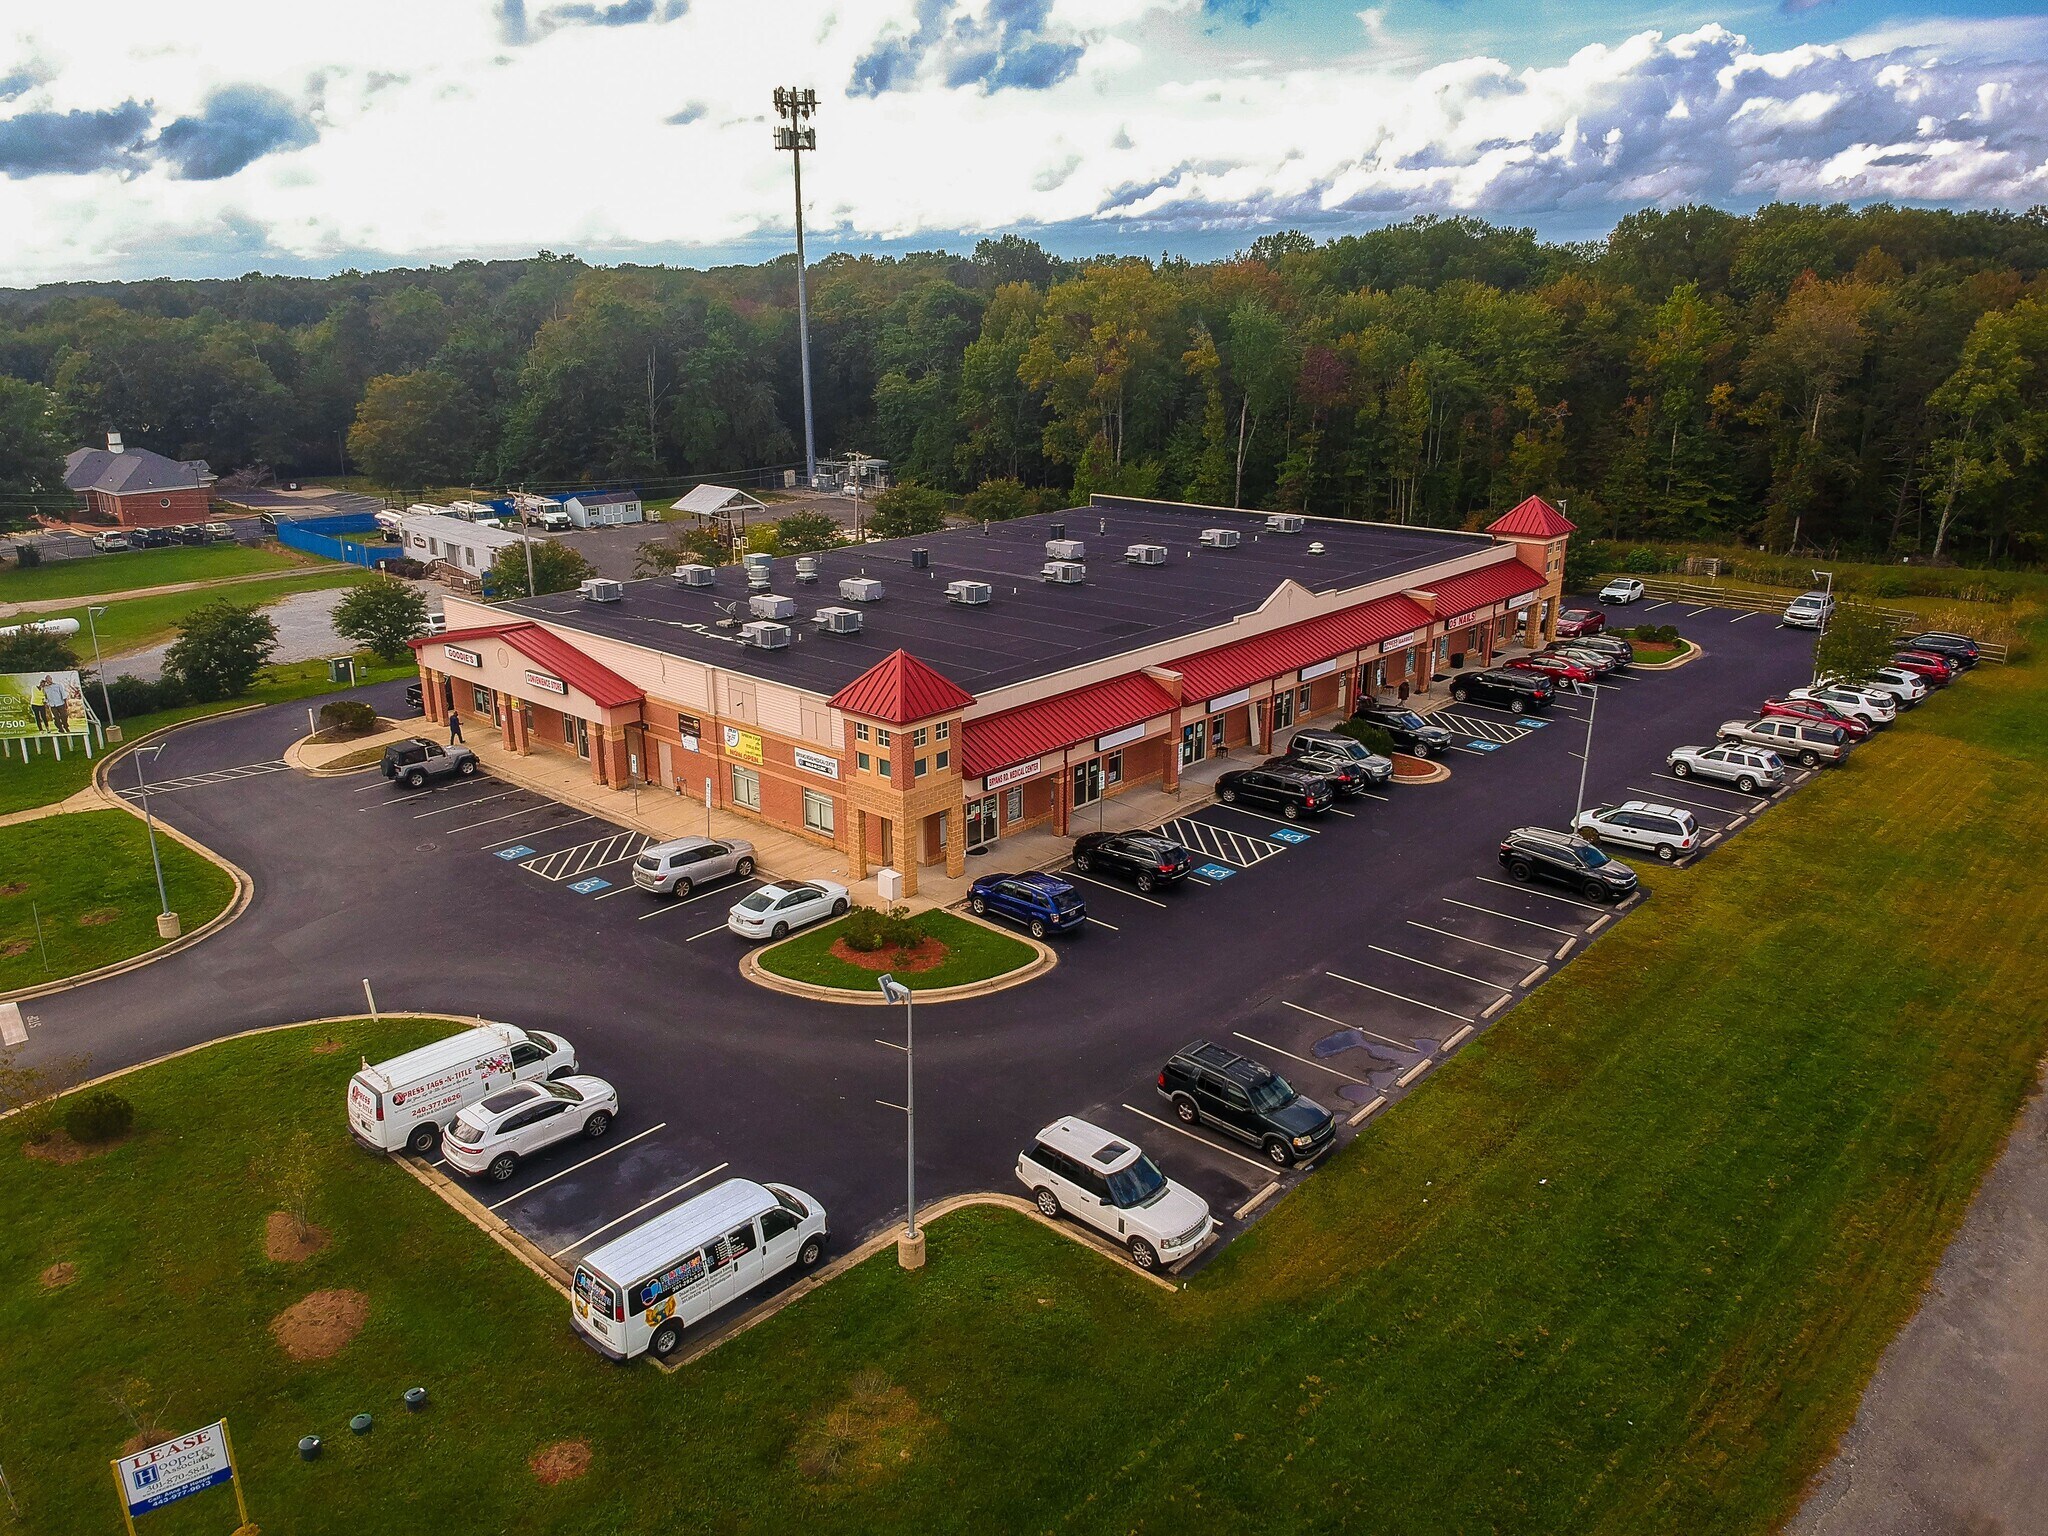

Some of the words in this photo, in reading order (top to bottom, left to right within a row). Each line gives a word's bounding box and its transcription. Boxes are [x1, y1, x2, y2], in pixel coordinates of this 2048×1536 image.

[1458, 611, 1476, 626] NAILS
[448, 648, 475, 664] GOODIE'S
[527, 673, 551, 689] CONVENIENCE
[550, 680, 563, 692] STORE
[743, 753, 759, 764] OPEN
[989, 773, 1003, 787] BRYANS
[1010, 767, 1025, 779] MEDICAL
[1025, 762, 1039, 774] CENTER
[426, 1078, 444, 1091] TAGS
[455, 1067, 473, 1080] TITLE
[131, 1430, 211, 1469] LEASE
[146, 1463, 210, 1493] 301-870-5841
[190, 1475, 214, 1487] Hooper
